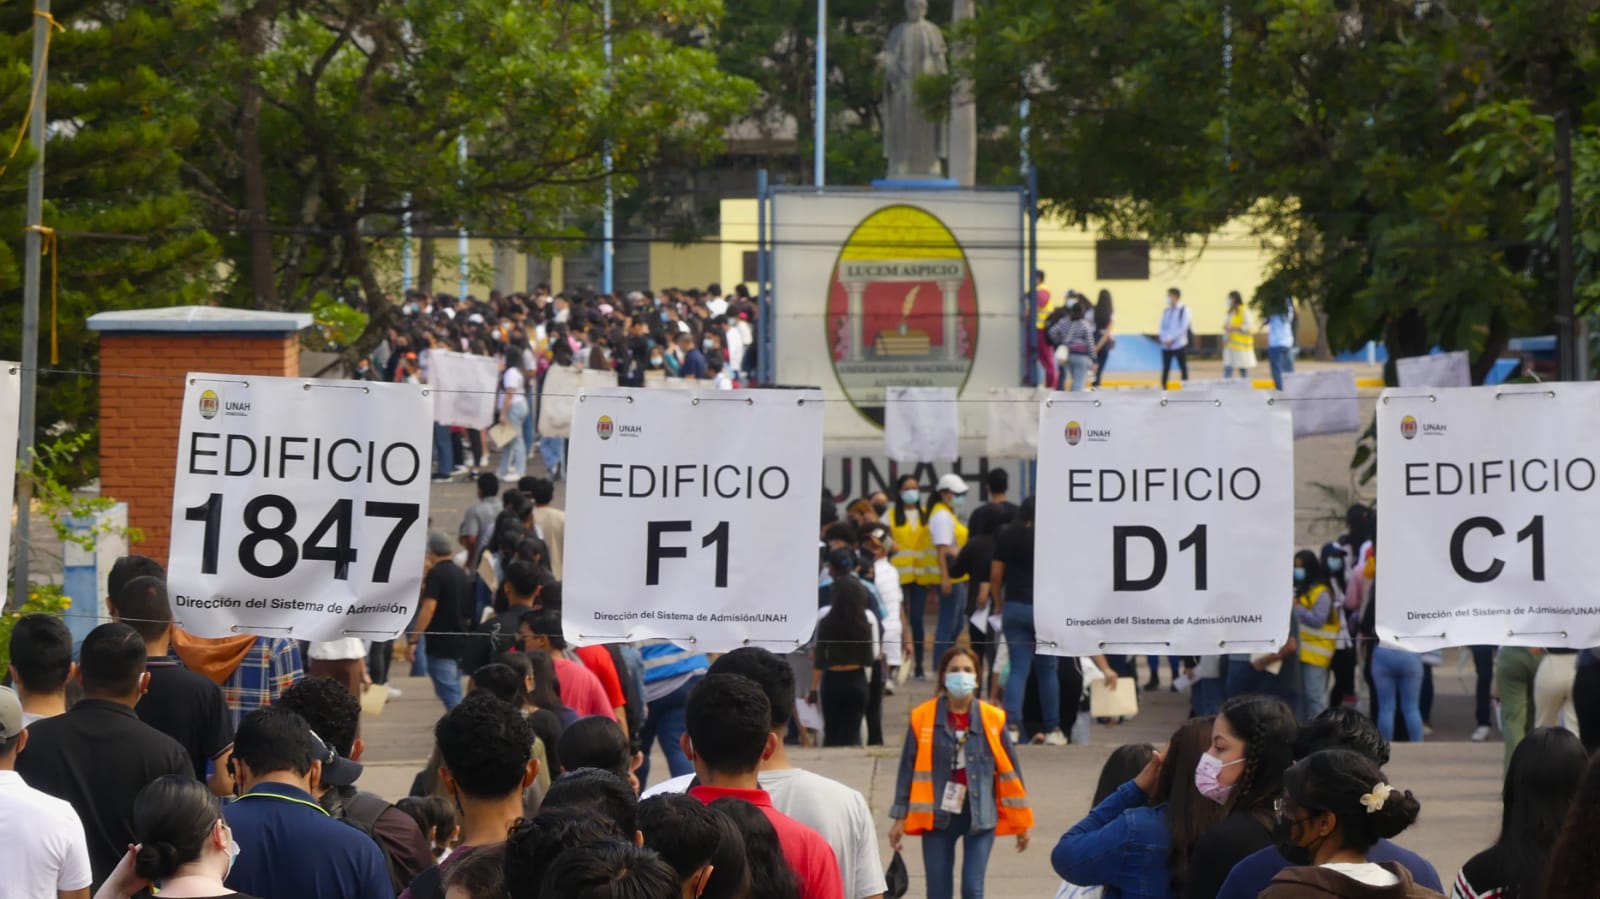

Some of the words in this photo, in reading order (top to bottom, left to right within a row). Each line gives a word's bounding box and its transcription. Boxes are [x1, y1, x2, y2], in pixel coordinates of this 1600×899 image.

[847, 265, 899, 277] LUCEM
[903, 265, 960, 277] ASPICIO
[913, 365, 965, 373] NACIONAL
[225, 402, 251, 411] UNAH
[619, 425, 642, 433] UNAH
[1087, 429, 1111, 438] UNAH
[189, 431, 420, 486] EDIFICIO
[599, 463, 790, 500] EDIFICIO
[1068, 466, 1261, 502] EDIFICIO
[1405, 457, 1596, 496] EDIFICIO
[185, 493, 420, 583] 1847
[645, 520, 730, 588] F1
[1112, 523, 1208, 592] D1
[1449, 514, 1546, 584] C1
[176, 595, 241, 609] Dirección
[245, 598, 267, 609] del
[271, 598, 324, 612] Sistema
[327, 602, 343, 614] de
[346, 602, 408, 615] Admisión
[1407, 610, 1452, 620] Dirección
[1455, 609, 1470, 617] del
[1472, 607, 1511, 617] Sistema
[1514, 606, 1525, 615] de
[1528, 605, 1600, 616] Admisión/UNAH
[594, 611, 638, 621] Dirección
[640, 610, 655, 619] del
[657, 610, 694, 621] Sistema
[696, 613, 708, 622] de
[710, 613, 787, 623] Admisión/UNAH
[1066, 616, 1111, 627] Dirección
[1114, 616, 1129, 625] del
[1131, 616, 1170, 626] Sistema
[1172, 616, 1185, 626] de
[1186, 614, 1262, 626] Admisión/UNAH
